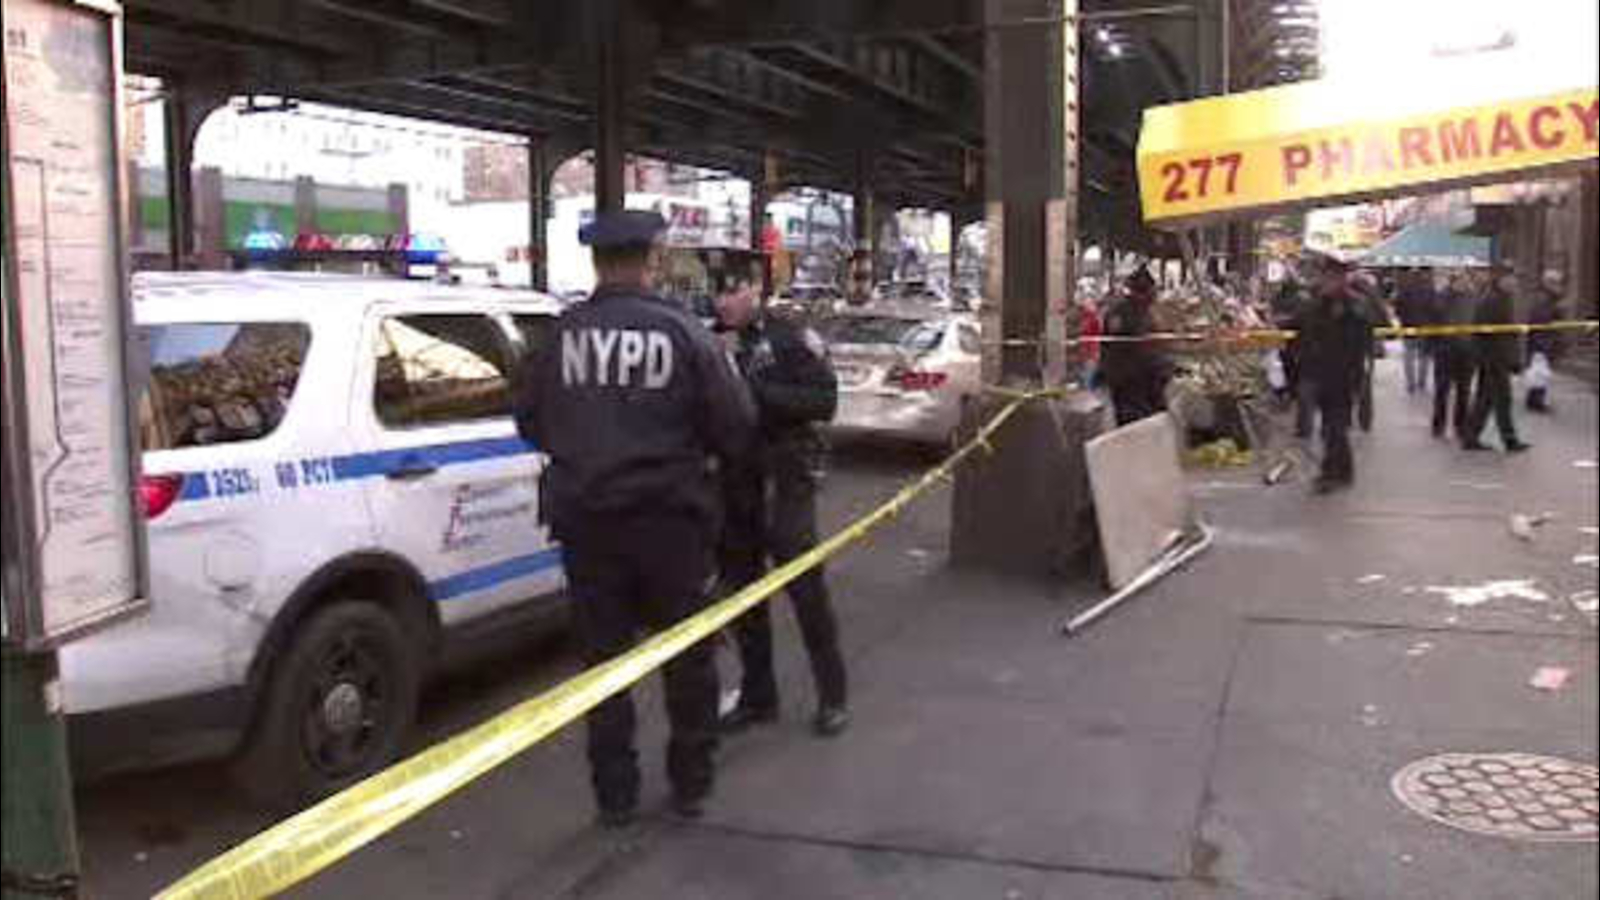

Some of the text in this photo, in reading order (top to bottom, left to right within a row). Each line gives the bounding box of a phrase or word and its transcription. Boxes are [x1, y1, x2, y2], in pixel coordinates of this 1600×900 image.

[1161, 98, 1599, 203] 277 PHARMACY
[562, 328, 673, 389] NYPD
